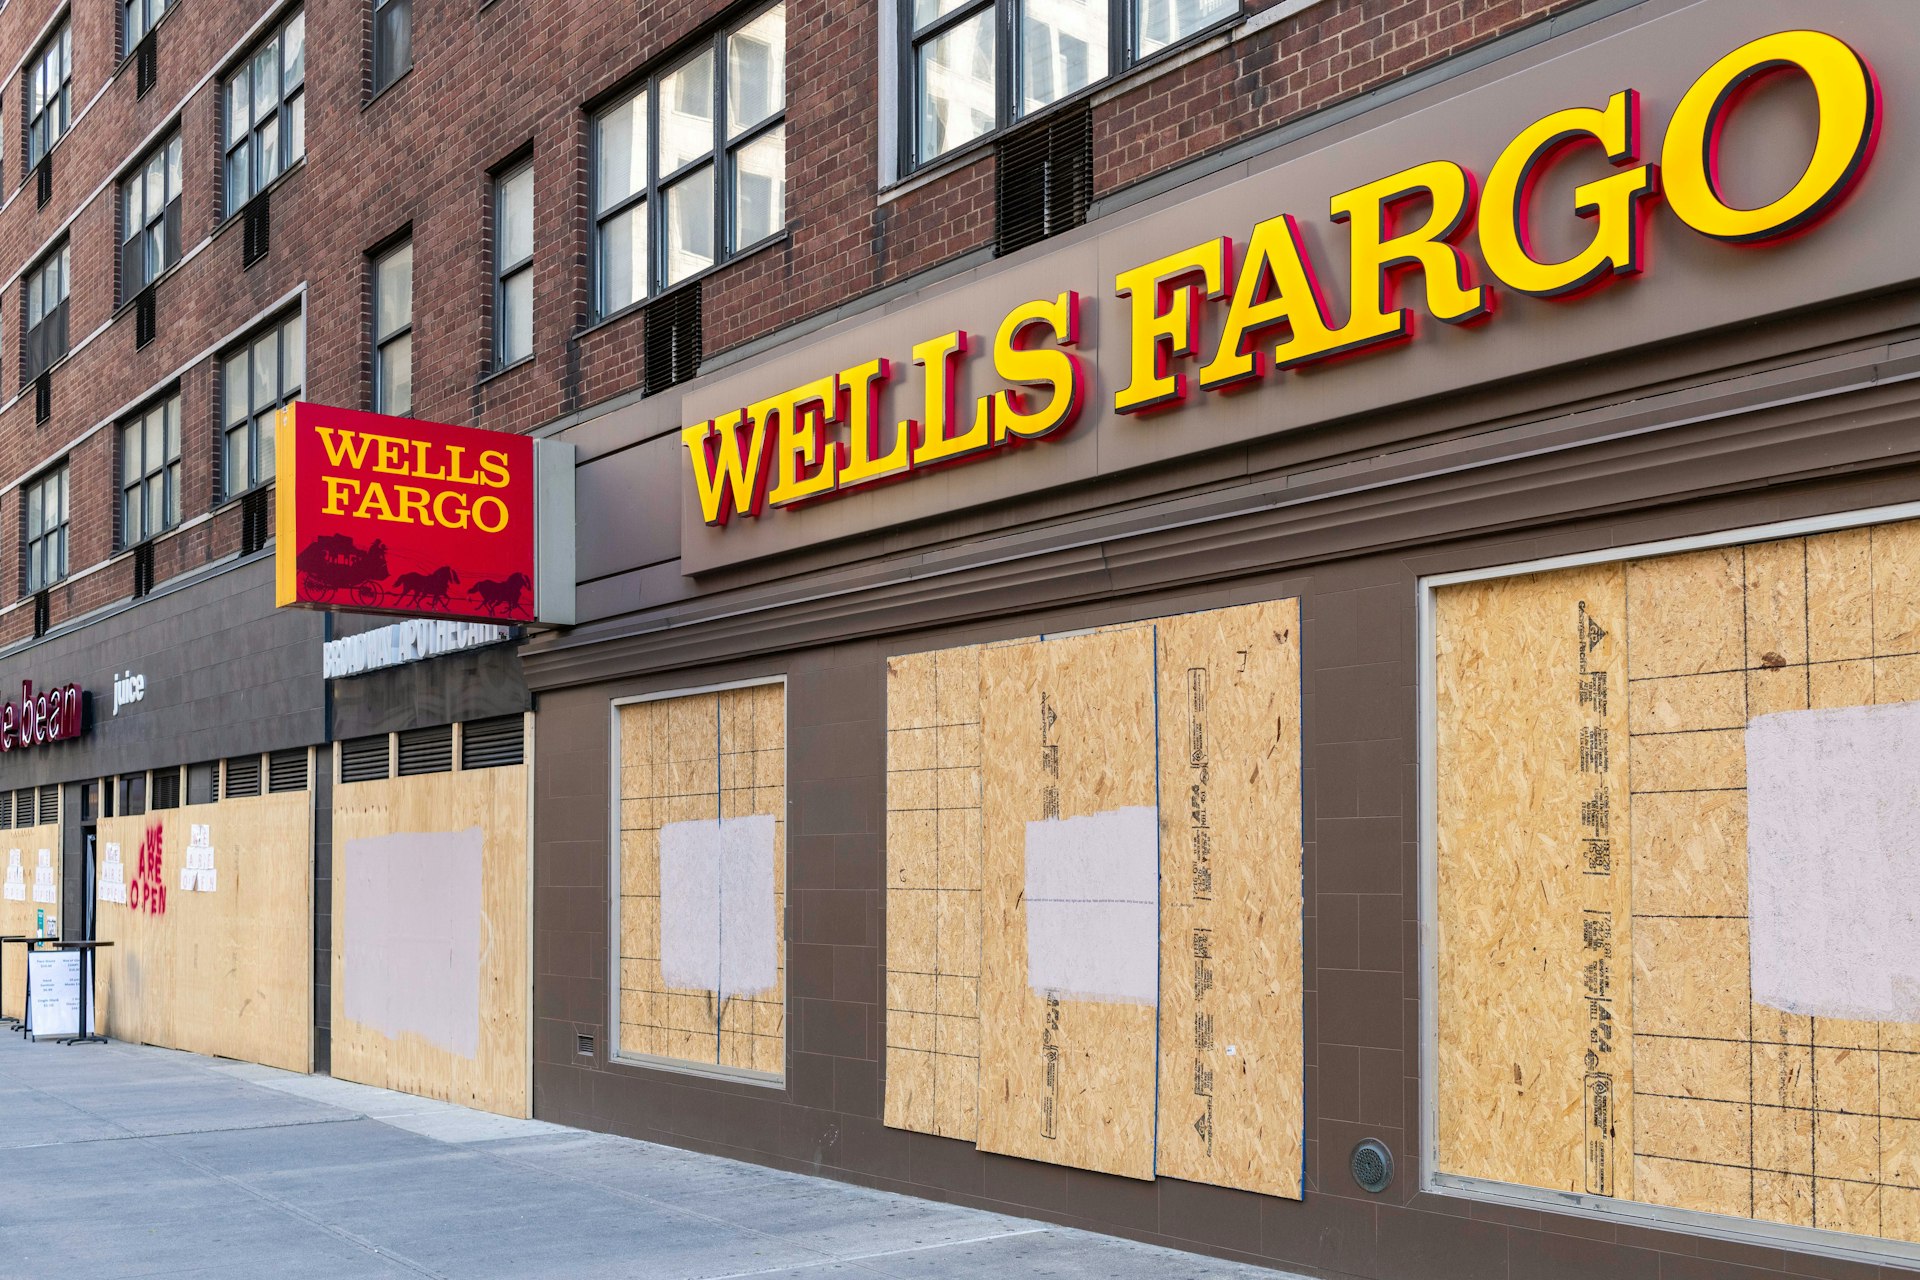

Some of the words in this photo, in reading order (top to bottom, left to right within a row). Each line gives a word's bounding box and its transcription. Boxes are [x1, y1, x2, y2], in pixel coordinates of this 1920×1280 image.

[682, 290, 1084, 527] WELLS
[1114, 29, 1883, 415] FARGO
[314, 426, 511, 488] WELLS
[321, 475, 510, 533] FARGO
[323, 624, 398, 679] BROADWAY
[1577, 600, 1587, 673] Georgia-Pacific
[1589, 624, 1599, 643] GP
[20, 679, 82, 748] bean
[112, 670, 146, 716] juice
[1191, 785, 1201, 823] APA
[146, 823, 163, 856] WE
[1595, 843, 1604, 867] 2019
[138, 843, 162, 884] ARE
[130, 879, 167, 916] OPEN
[1590, 1000, 1598, 1021] MILL
[1598, 1004, 1612, 1053] APA
[1590, 1027, 1598, 1044] 451
